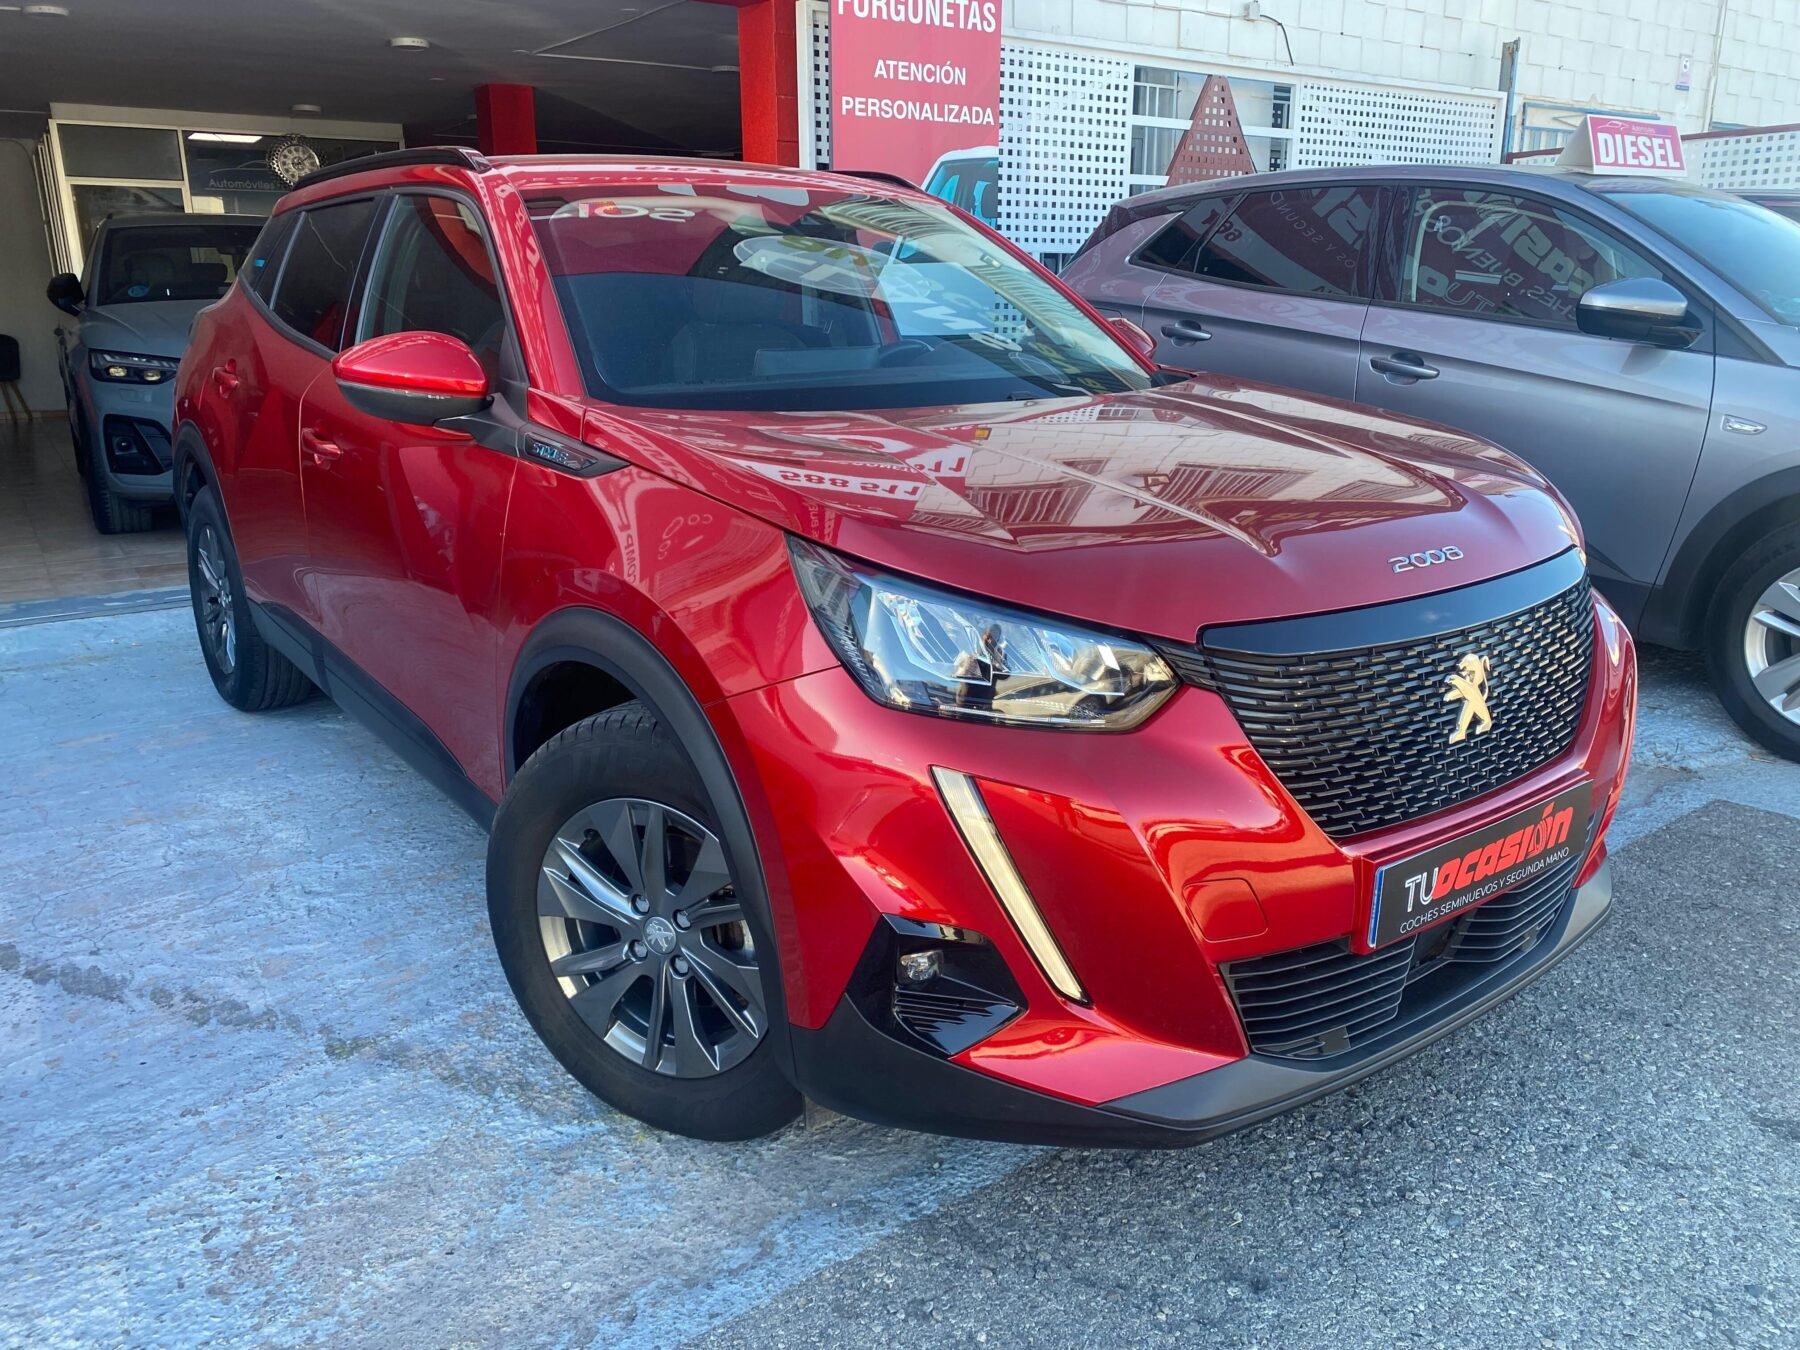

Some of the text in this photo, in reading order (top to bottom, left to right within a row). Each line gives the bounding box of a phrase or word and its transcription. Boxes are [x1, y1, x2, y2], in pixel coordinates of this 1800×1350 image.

[874, 59, 967, 86] ATENCIÓN
[841, 96, 995, 126] PERSONALIZADA
[1597, 132, 1681, 168] DIESEL
[1387, 545, 1464, 574] 2008
[1400, 846, 1570, 934] COCHES SEMINUEVOS Y SEGUNDA MANO
